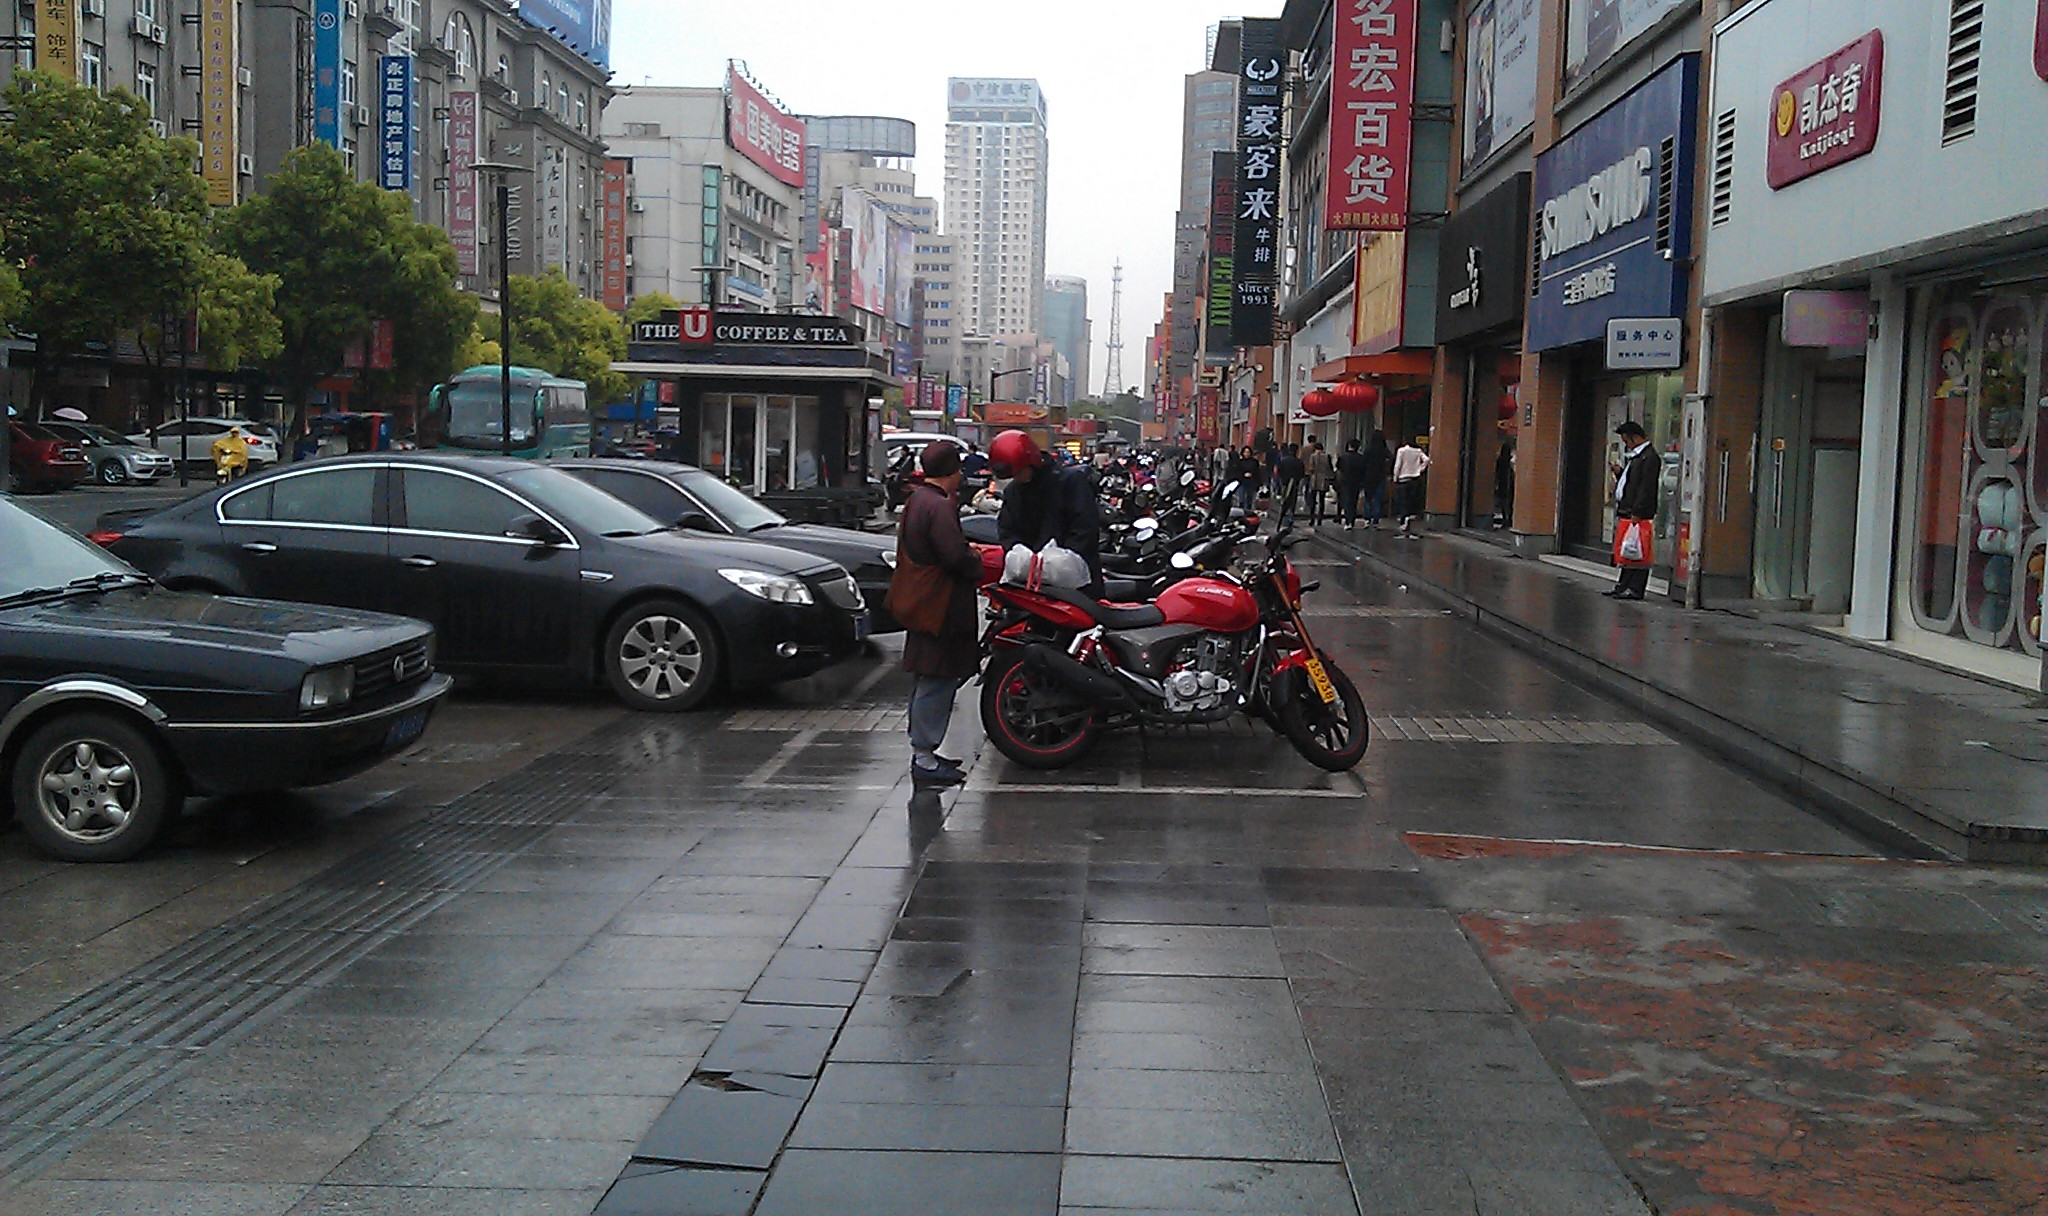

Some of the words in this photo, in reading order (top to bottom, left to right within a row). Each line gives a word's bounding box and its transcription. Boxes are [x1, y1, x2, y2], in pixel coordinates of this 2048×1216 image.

[1344, 0, 1398, 205] 名宏百货
[1239, 103, 1281, 221] 豪客来
[1541, 146, 1651, 261] SAMSUNG
[506, 185, 523, 261] YOUNGOR
[1253, 227, 1271, 263] 牛排
[1238, 282, 1270, 294] Since
[1241, 294, 1269, 305] 1993
[641, 324, 680, 339] THE
[684, 314, 708, 339] U
[715, 325, 790, 341] COFFEE
[792, 326, 808, 341] &
[810, 327, 849, 342] TEA
[1616, 329, 1674, 342] 服务中心
